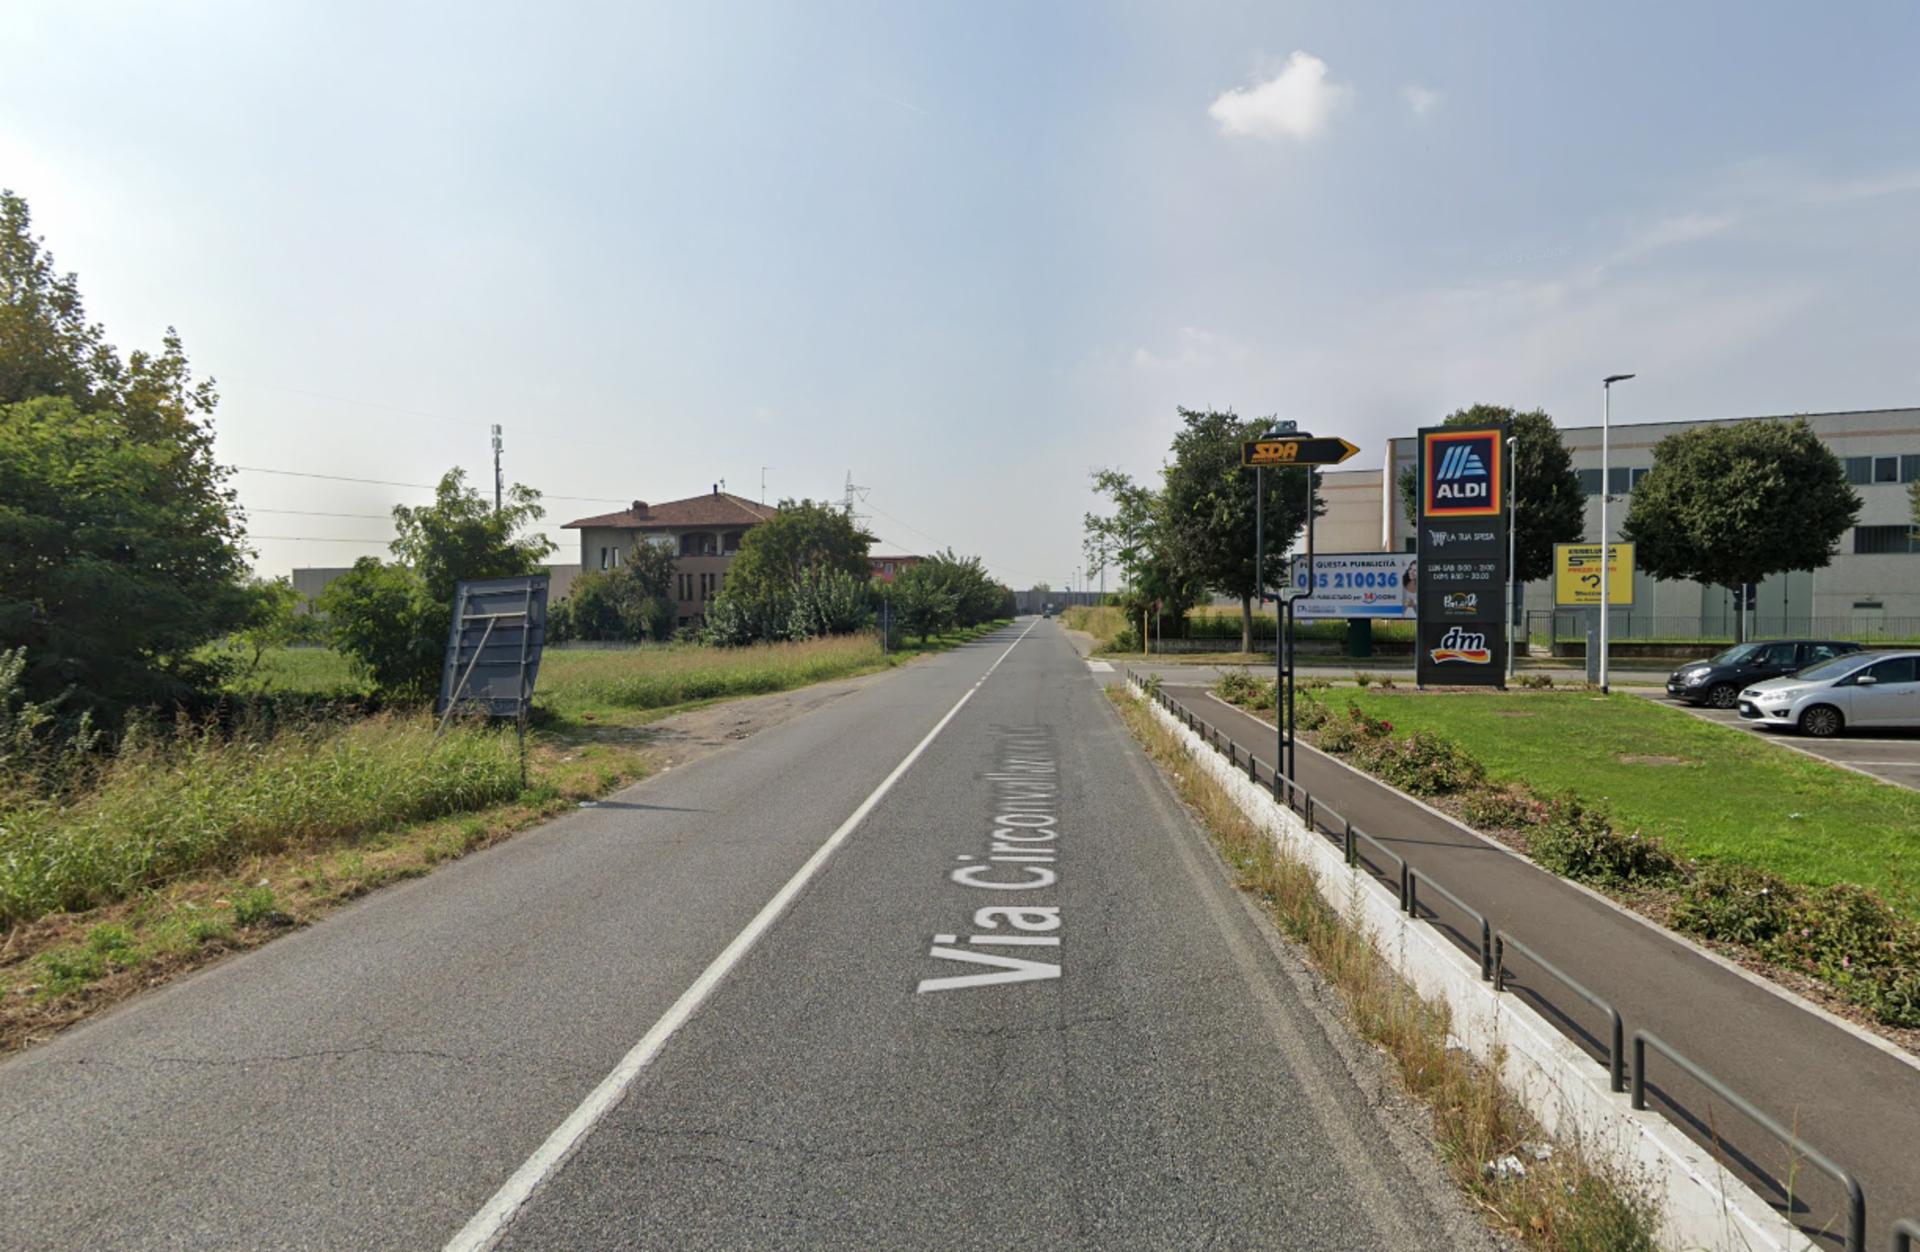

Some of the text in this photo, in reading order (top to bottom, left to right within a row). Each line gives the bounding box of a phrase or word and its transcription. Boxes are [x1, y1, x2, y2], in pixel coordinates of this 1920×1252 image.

[1252, 441, 1299, 459] SDA
[1436, 482, 1488, 499] ALDI
[1316, 561, 1347, 569] QUESTA
[1334, 572, 1399, 589] 210036
[1442, 628, 1484, 651] dm
